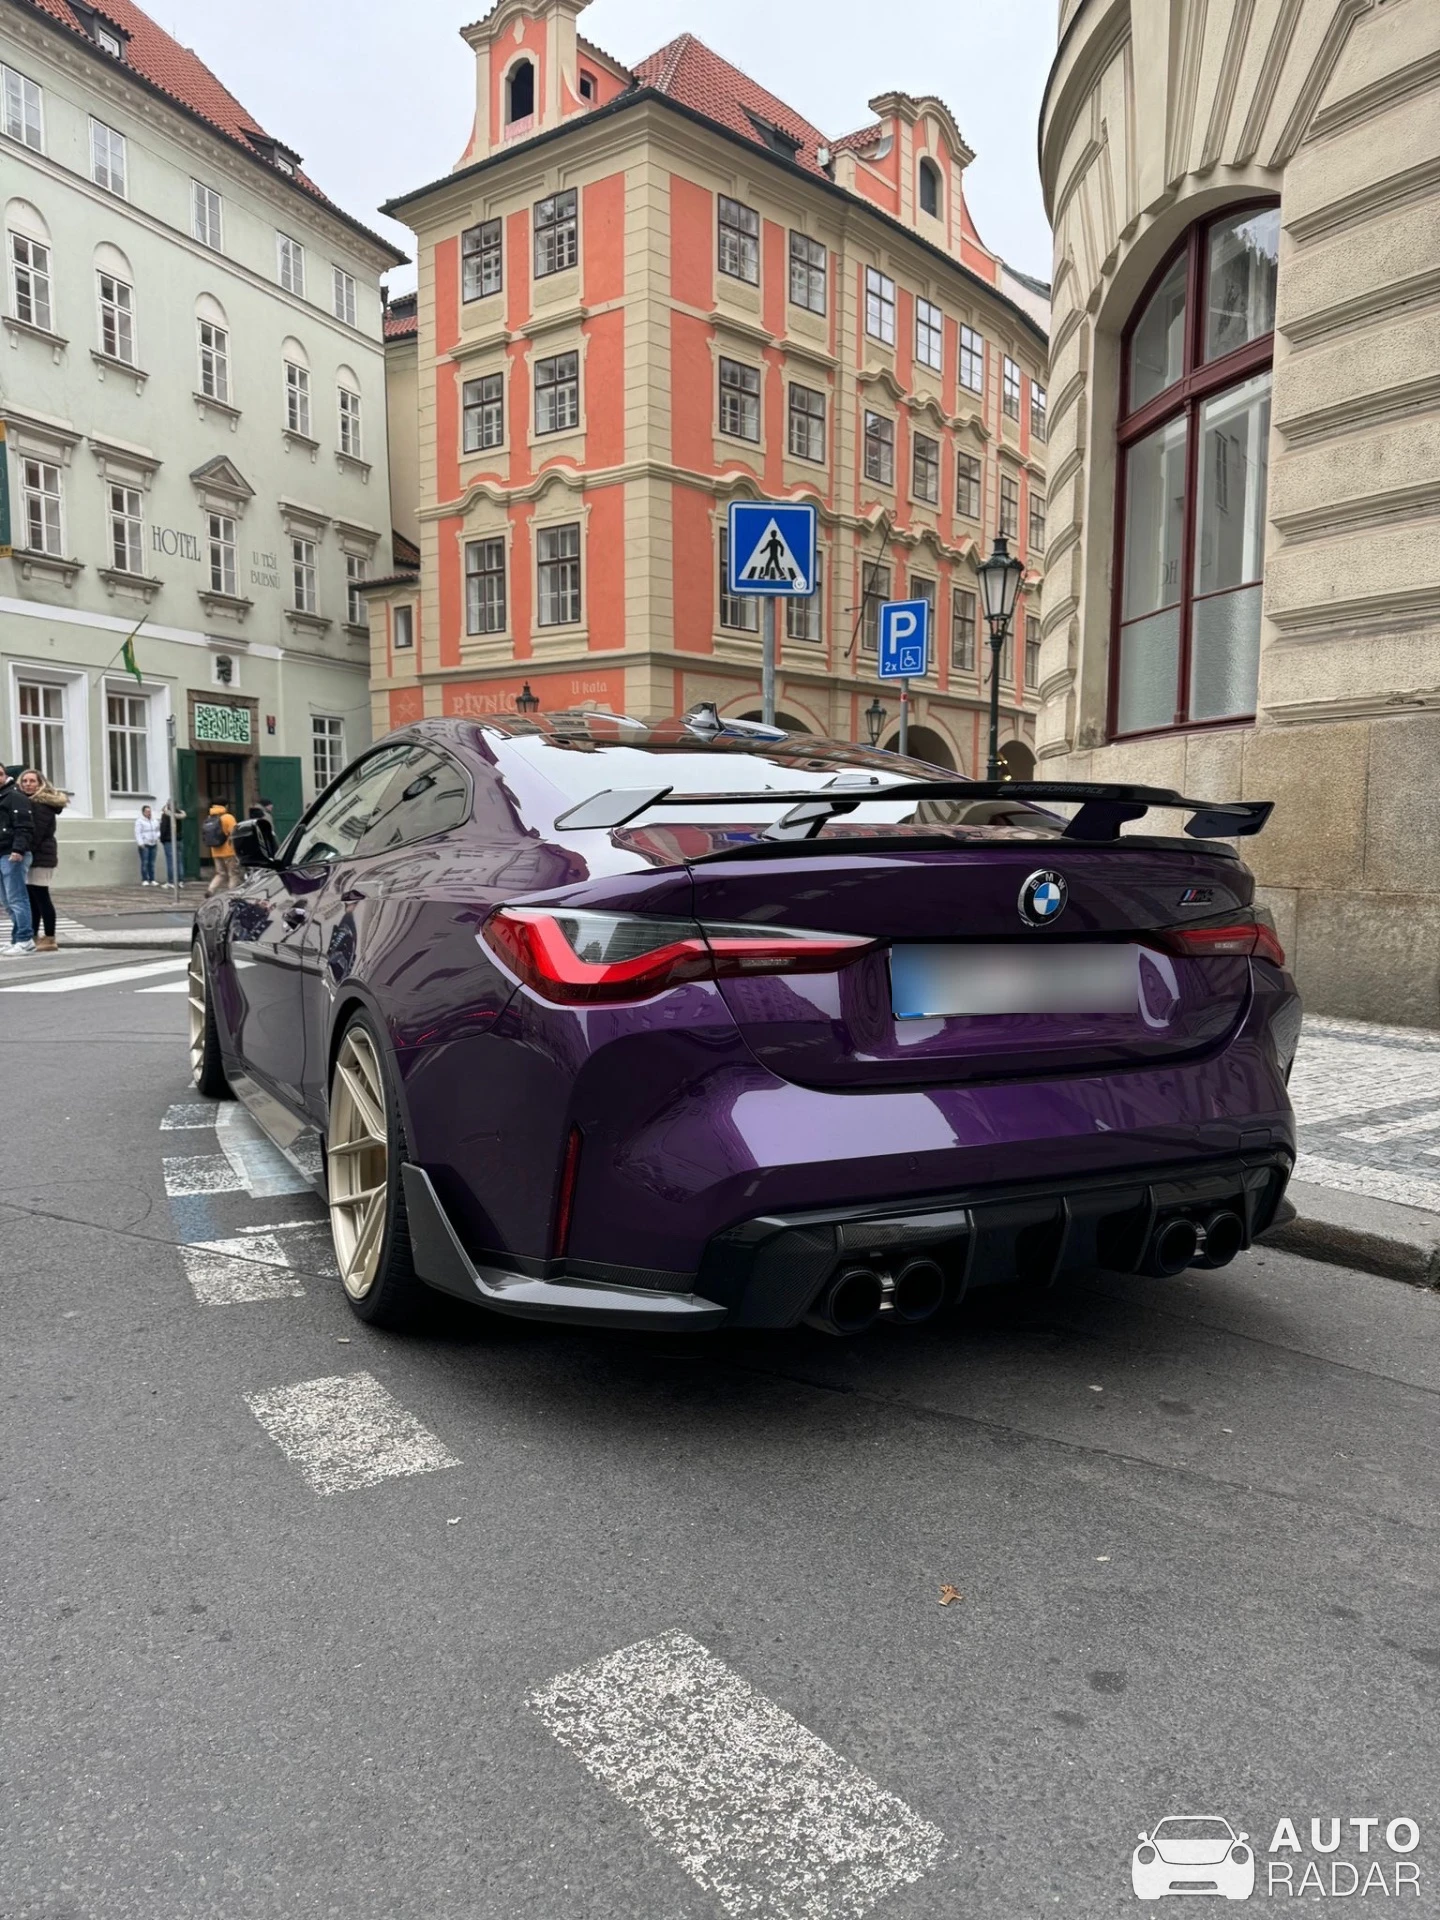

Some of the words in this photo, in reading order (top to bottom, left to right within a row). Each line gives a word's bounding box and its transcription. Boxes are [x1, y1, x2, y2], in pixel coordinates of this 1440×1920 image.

[151, 525, 201, 562] HOTEL
[252, 551, 259, 565] U
[889, 611, 917, 654] P
[885, 661, 897, 672] 2x
